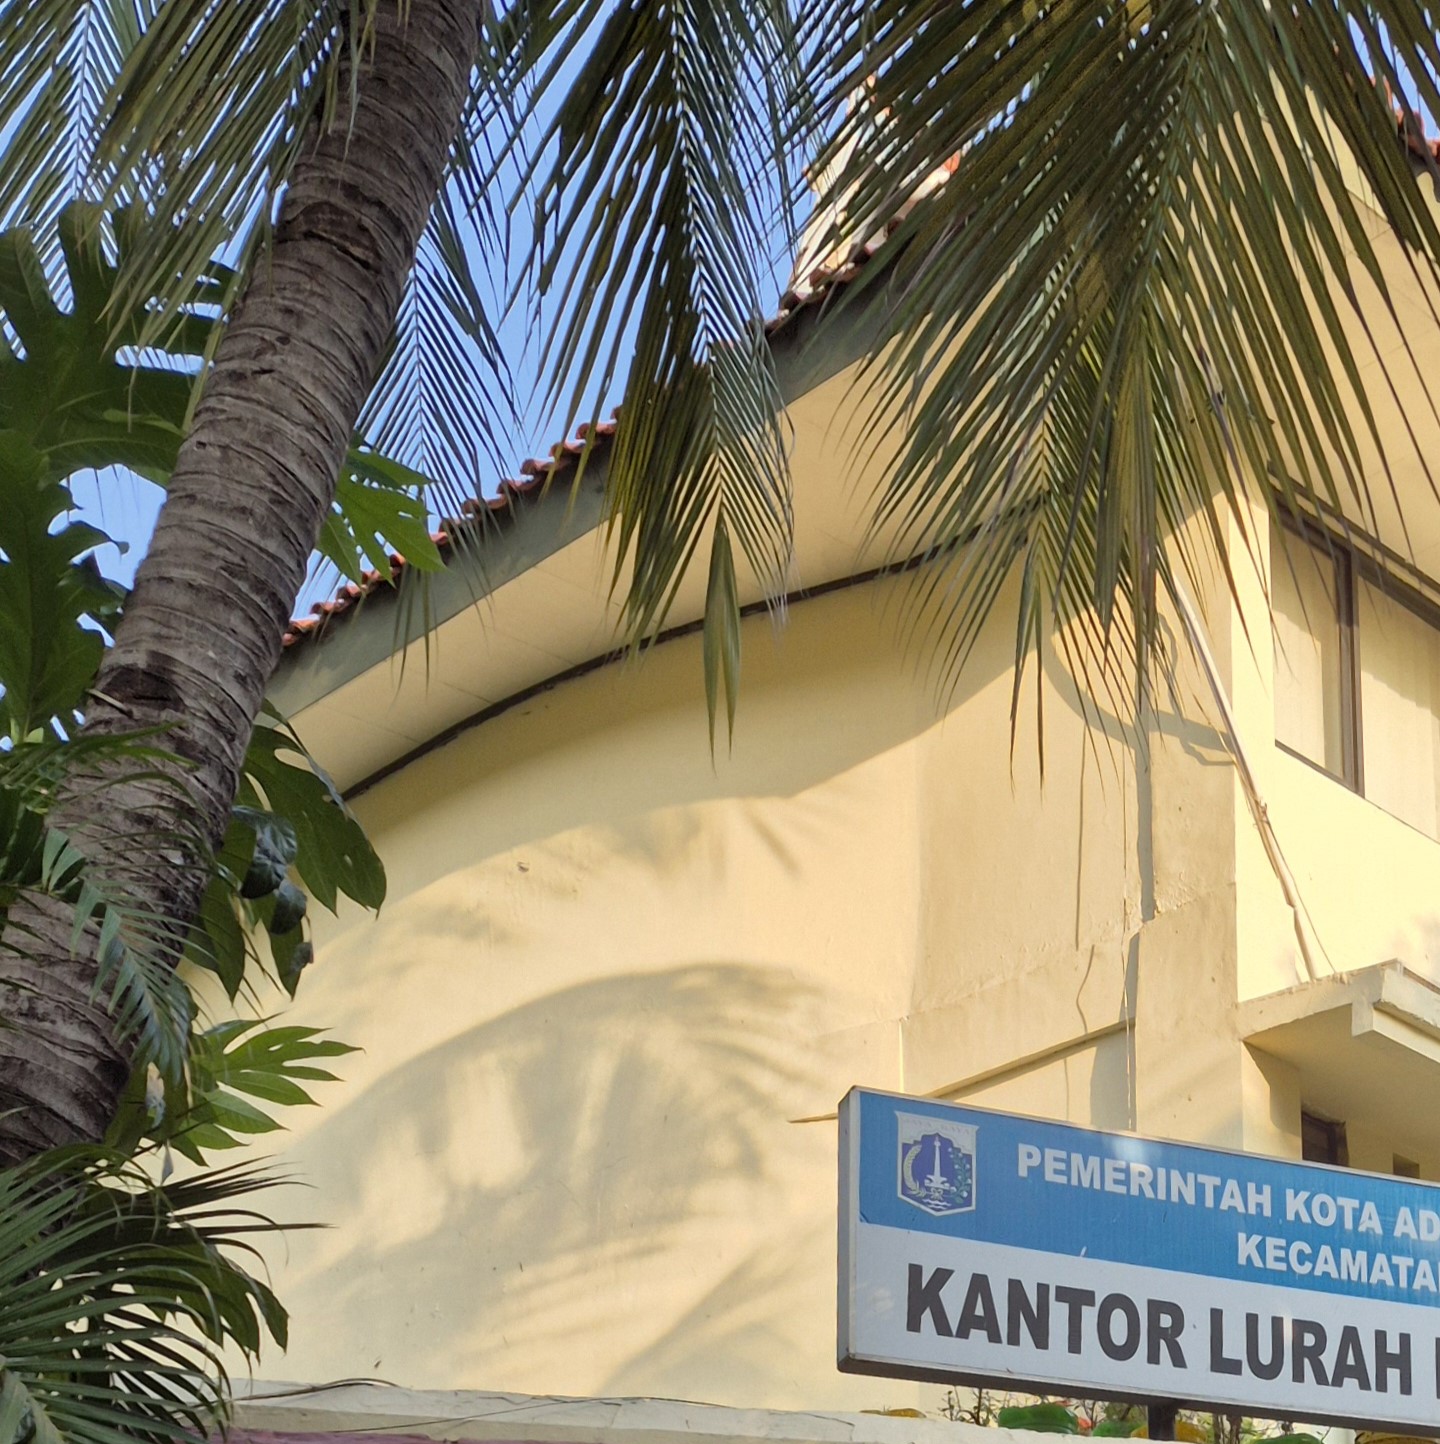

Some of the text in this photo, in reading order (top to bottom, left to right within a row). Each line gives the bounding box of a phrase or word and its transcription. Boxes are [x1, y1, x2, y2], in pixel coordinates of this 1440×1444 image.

[1017, 1143, 1272, 1218] PEMERINTAH
[1285, 1188, 1383, 1235] KOTA
[906, 1263, 1187, 1369] KANTOR
[1209, 1307, 1413, 1396] LURAH
